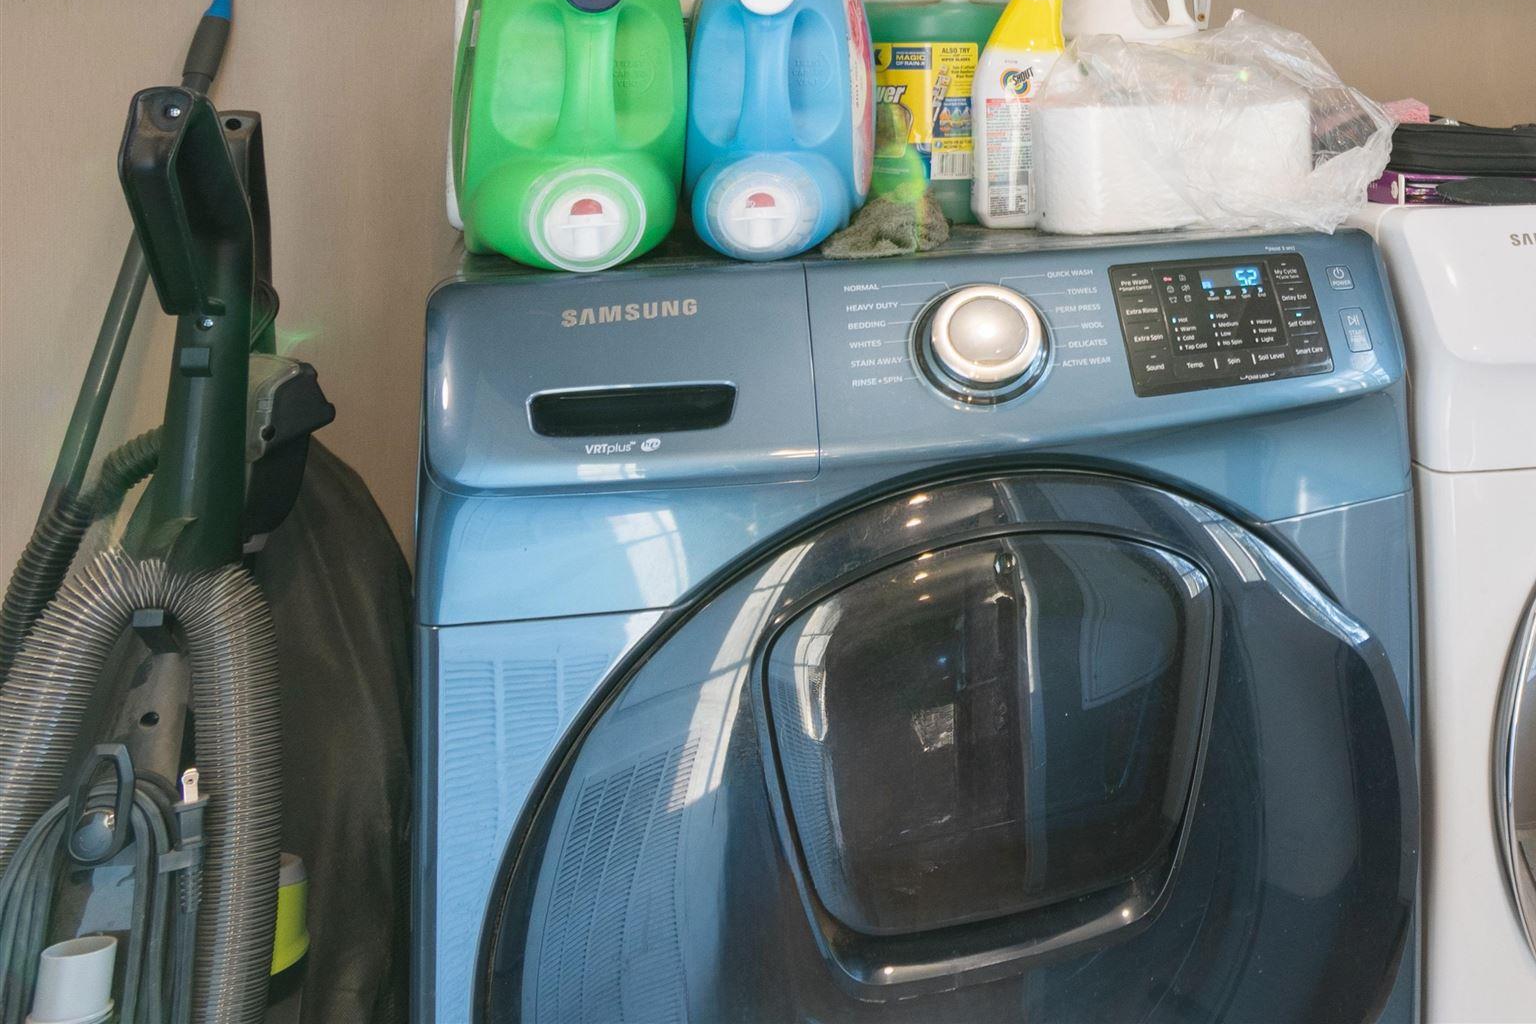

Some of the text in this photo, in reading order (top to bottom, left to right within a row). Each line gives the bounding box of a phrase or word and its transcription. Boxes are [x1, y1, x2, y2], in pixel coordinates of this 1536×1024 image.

[1047, 268, 1094, 278] QUICK WASH
[1284, 267, 1298, 275] Cycle
[844, 283, 880, 293] NORMAL
[1067, 286, 1098, 295] TOWELS
[1281, 295, 1296, 303] Delay
[846, 301, 899, 312] HEAVY DUTY
[1055, 303, 1101, 313] PERM PRESS
[561, 298, 697, 327] SAMSUNG
[848, 320, 886, 330] BEDDING
[1080, 321, 1104, 329] WOOL
[1068, 338, 1108, 348] DELICATES
[1150, 334, 1164, 342] Spin
[1231, 338, 1243, 346] Spin
[1261, 336, 1274, 344] Light
[849, 339, 882, 349] WHITES
[1296, 347, 1311, 355] Smart
[851, 356, 903, 368] STAIN AWAY
[1063, 356, 1111, 367] ACTIVE WEAR
[1227, 357, 1241, 365] Spin
[1146, 363, 1165, 371] Sound
[852, 375, 903, 388] RINSE SPIN
